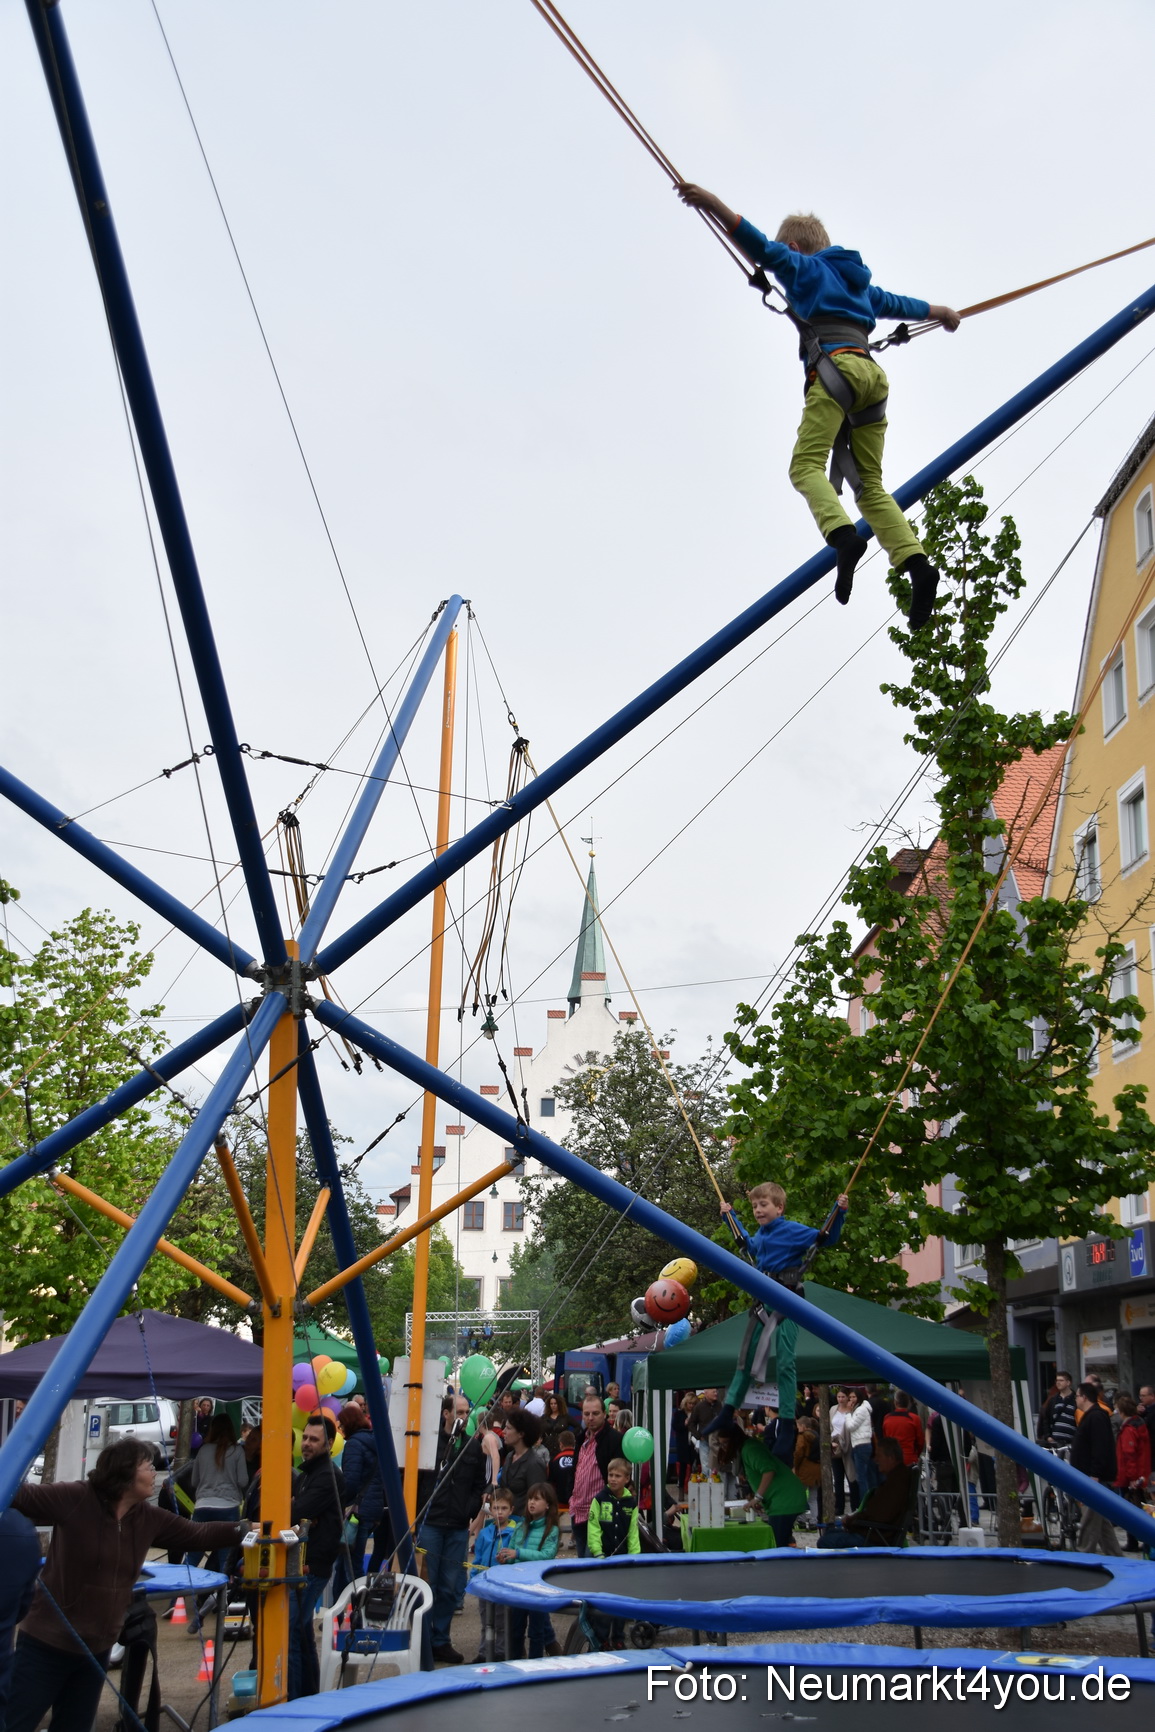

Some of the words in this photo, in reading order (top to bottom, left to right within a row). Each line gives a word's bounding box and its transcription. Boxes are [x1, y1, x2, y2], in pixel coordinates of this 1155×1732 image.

[1130, 1242, 1144, 1263] ivd
[92, 1417, 99, 1429] P
[600, 1501, 613, 1523] R
